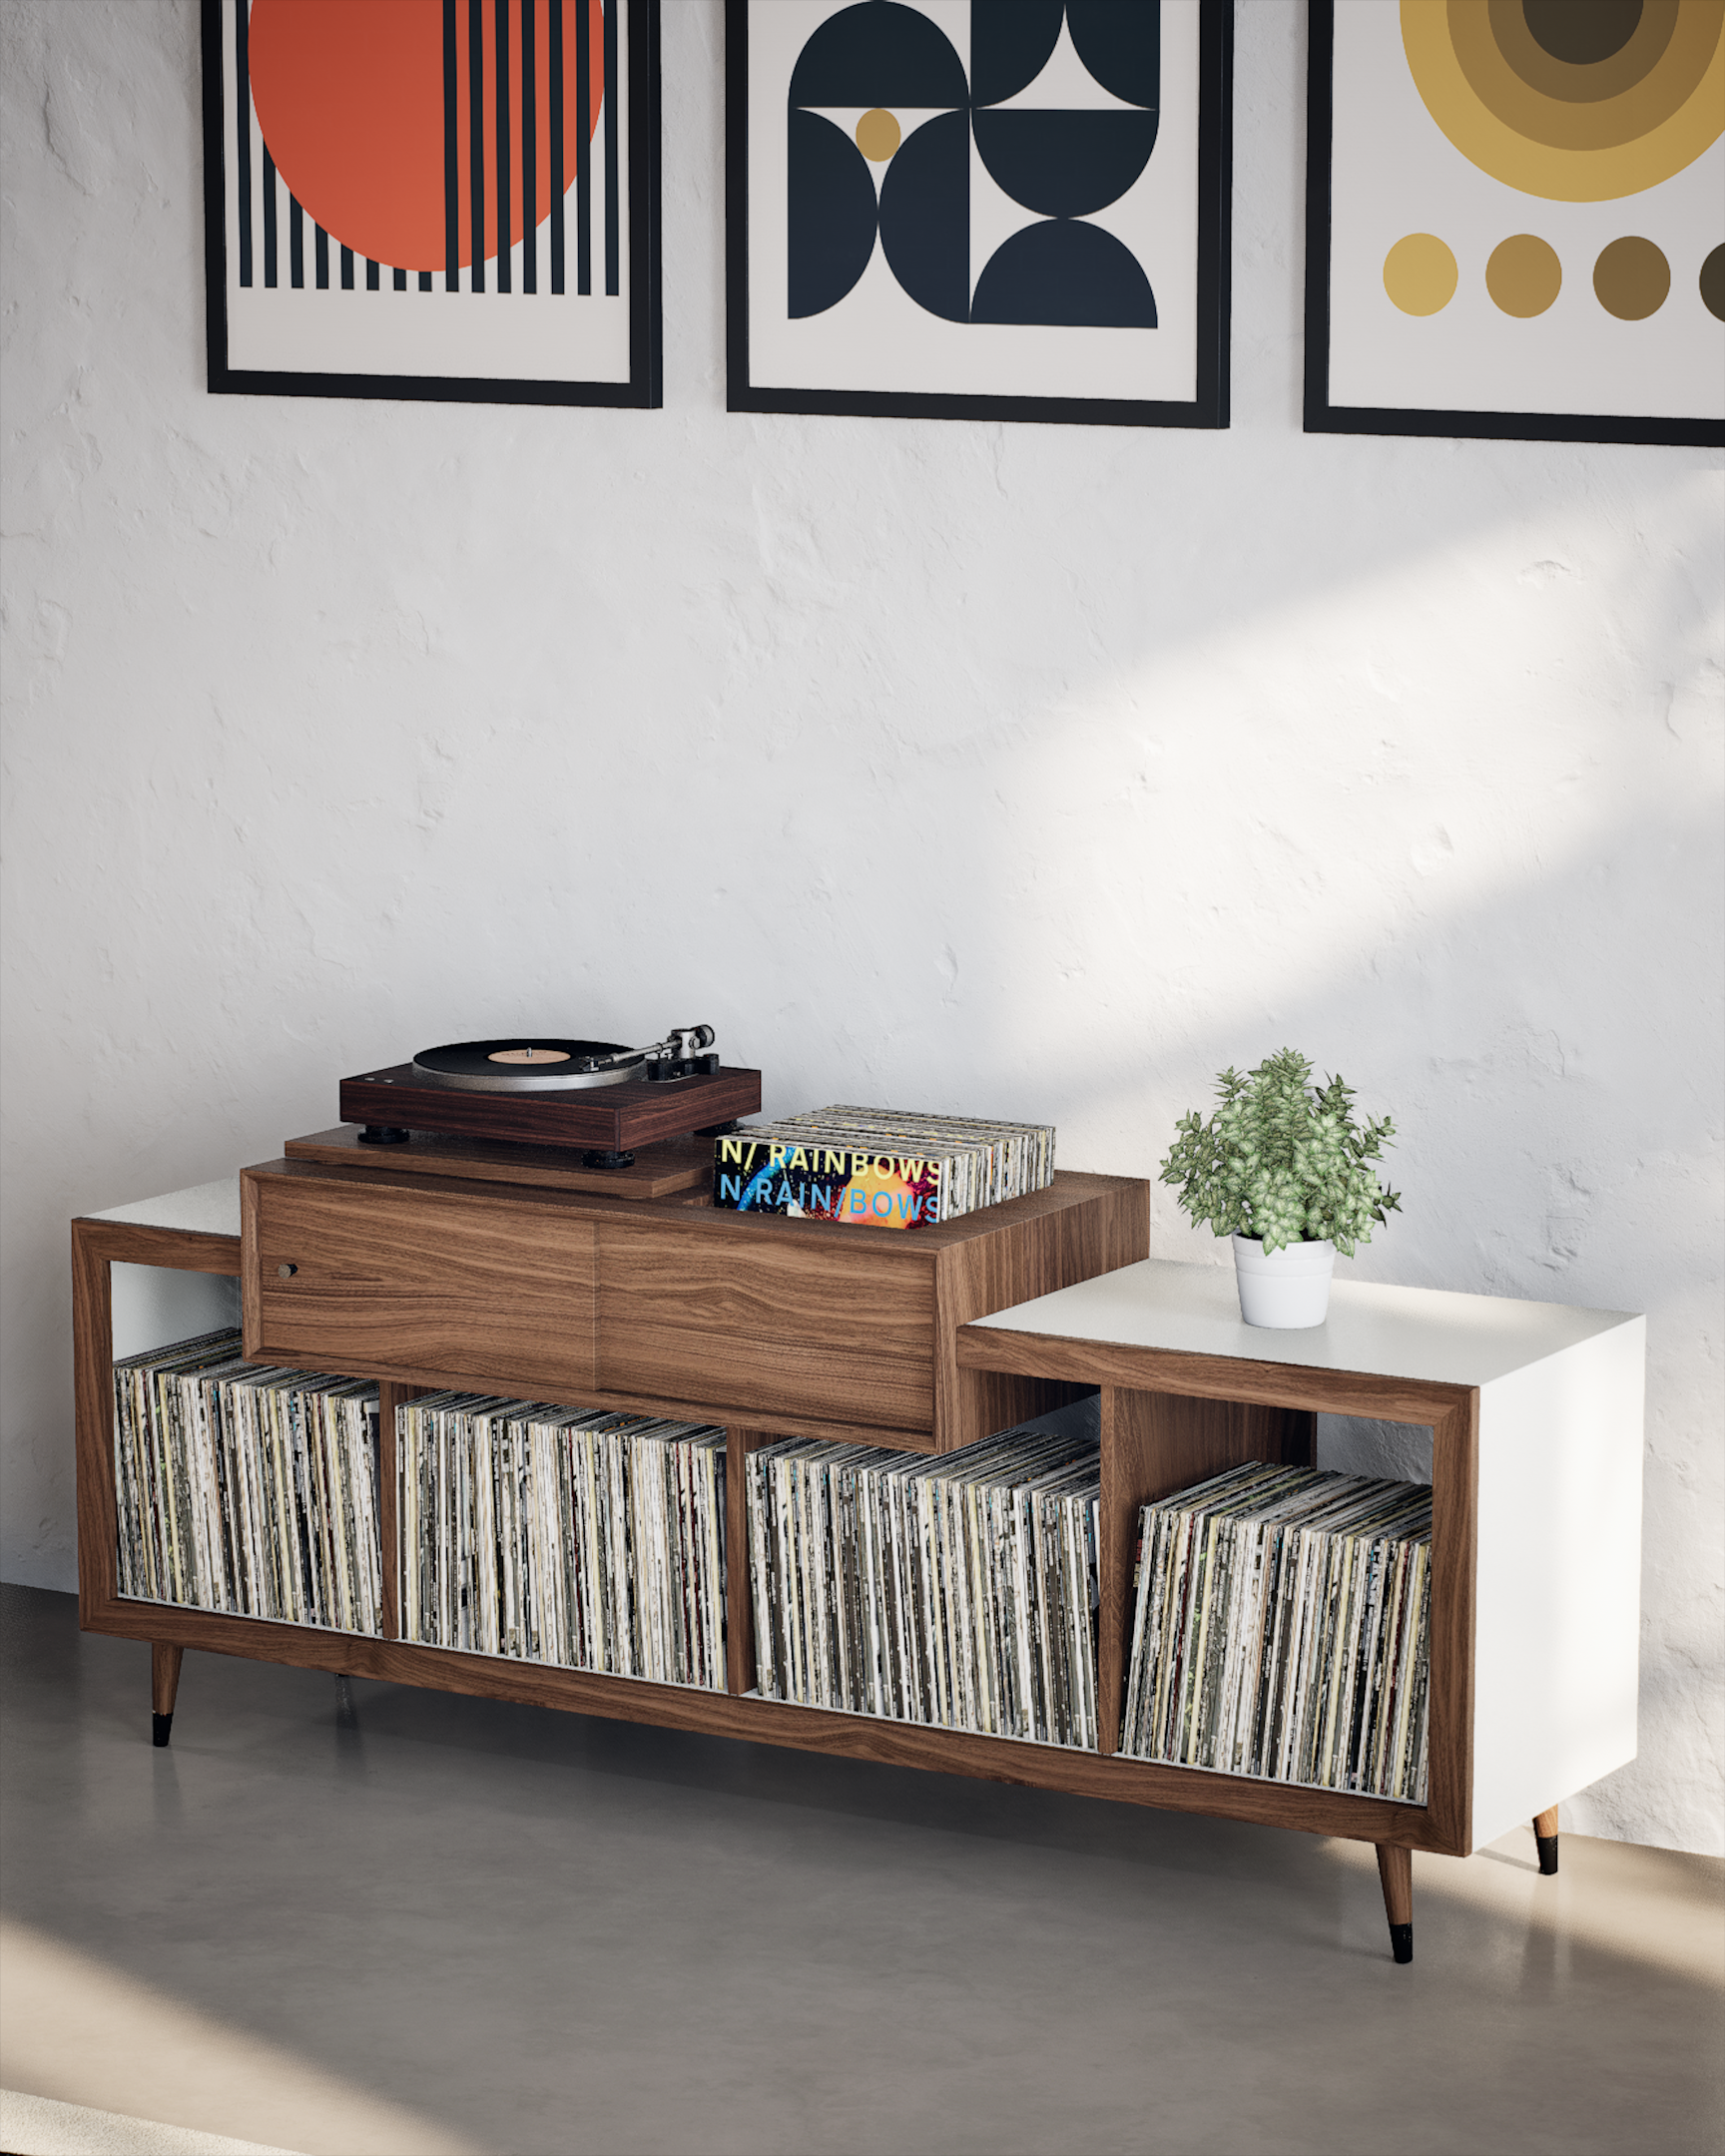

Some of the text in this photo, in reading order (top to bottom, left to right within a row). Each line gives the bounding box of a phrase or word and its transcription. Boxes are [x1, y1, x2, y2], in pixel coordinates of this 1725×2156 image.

[722, 1139, 757, 1172] N/
[770, 1144, 939, 1186] RAINBOWS
[720, 1173, 741, 1202] N
